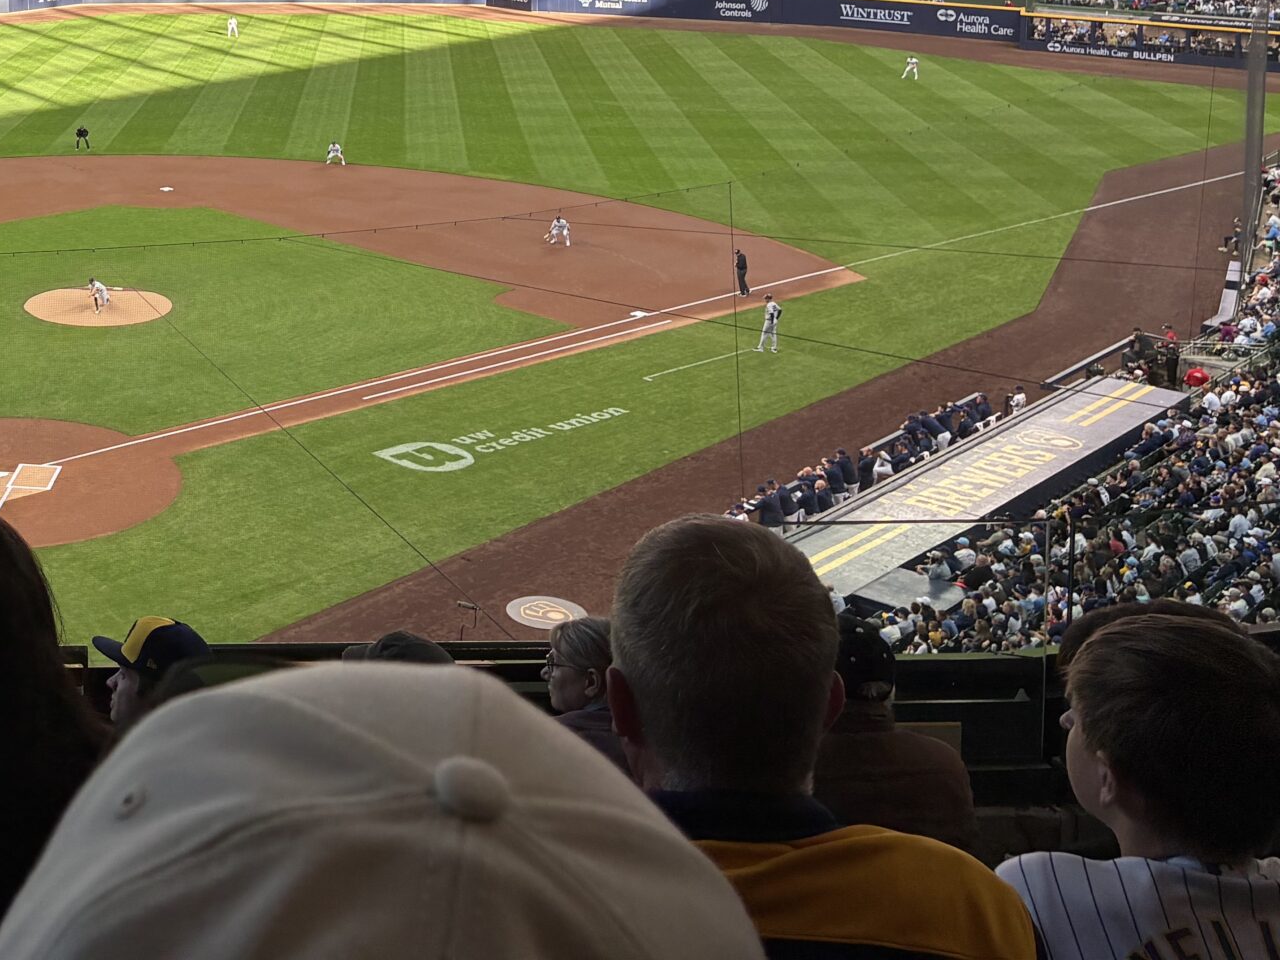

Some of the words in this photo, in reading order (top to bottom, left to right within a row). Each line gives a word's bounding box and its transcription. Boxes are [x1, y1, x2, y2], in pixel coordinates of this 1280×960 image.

[595, 1, 623, 9] Mutual
[715, 0, 746, 10] Johnson
[720, 8, 752, 18] Controls
[840, 4, 912, 22] WINTRUST
[957, 13, 989, 25] Aurora
[957, 22, 993, 34] Health
[994, 24, 1013, 36] Care
[1061, 44, 1084, 54] Aurora
[1085, 46, 1106, 56] Health
[1108, 48, 1128, 57] Care
[1132, 51, 1174, 62] BULLPEN
[451, 429, 496, 445] uw
[474, 427, 554, 454] credit
[548, 406, 631, 432] union
[904, 444, 1058, 517] BREWERS
